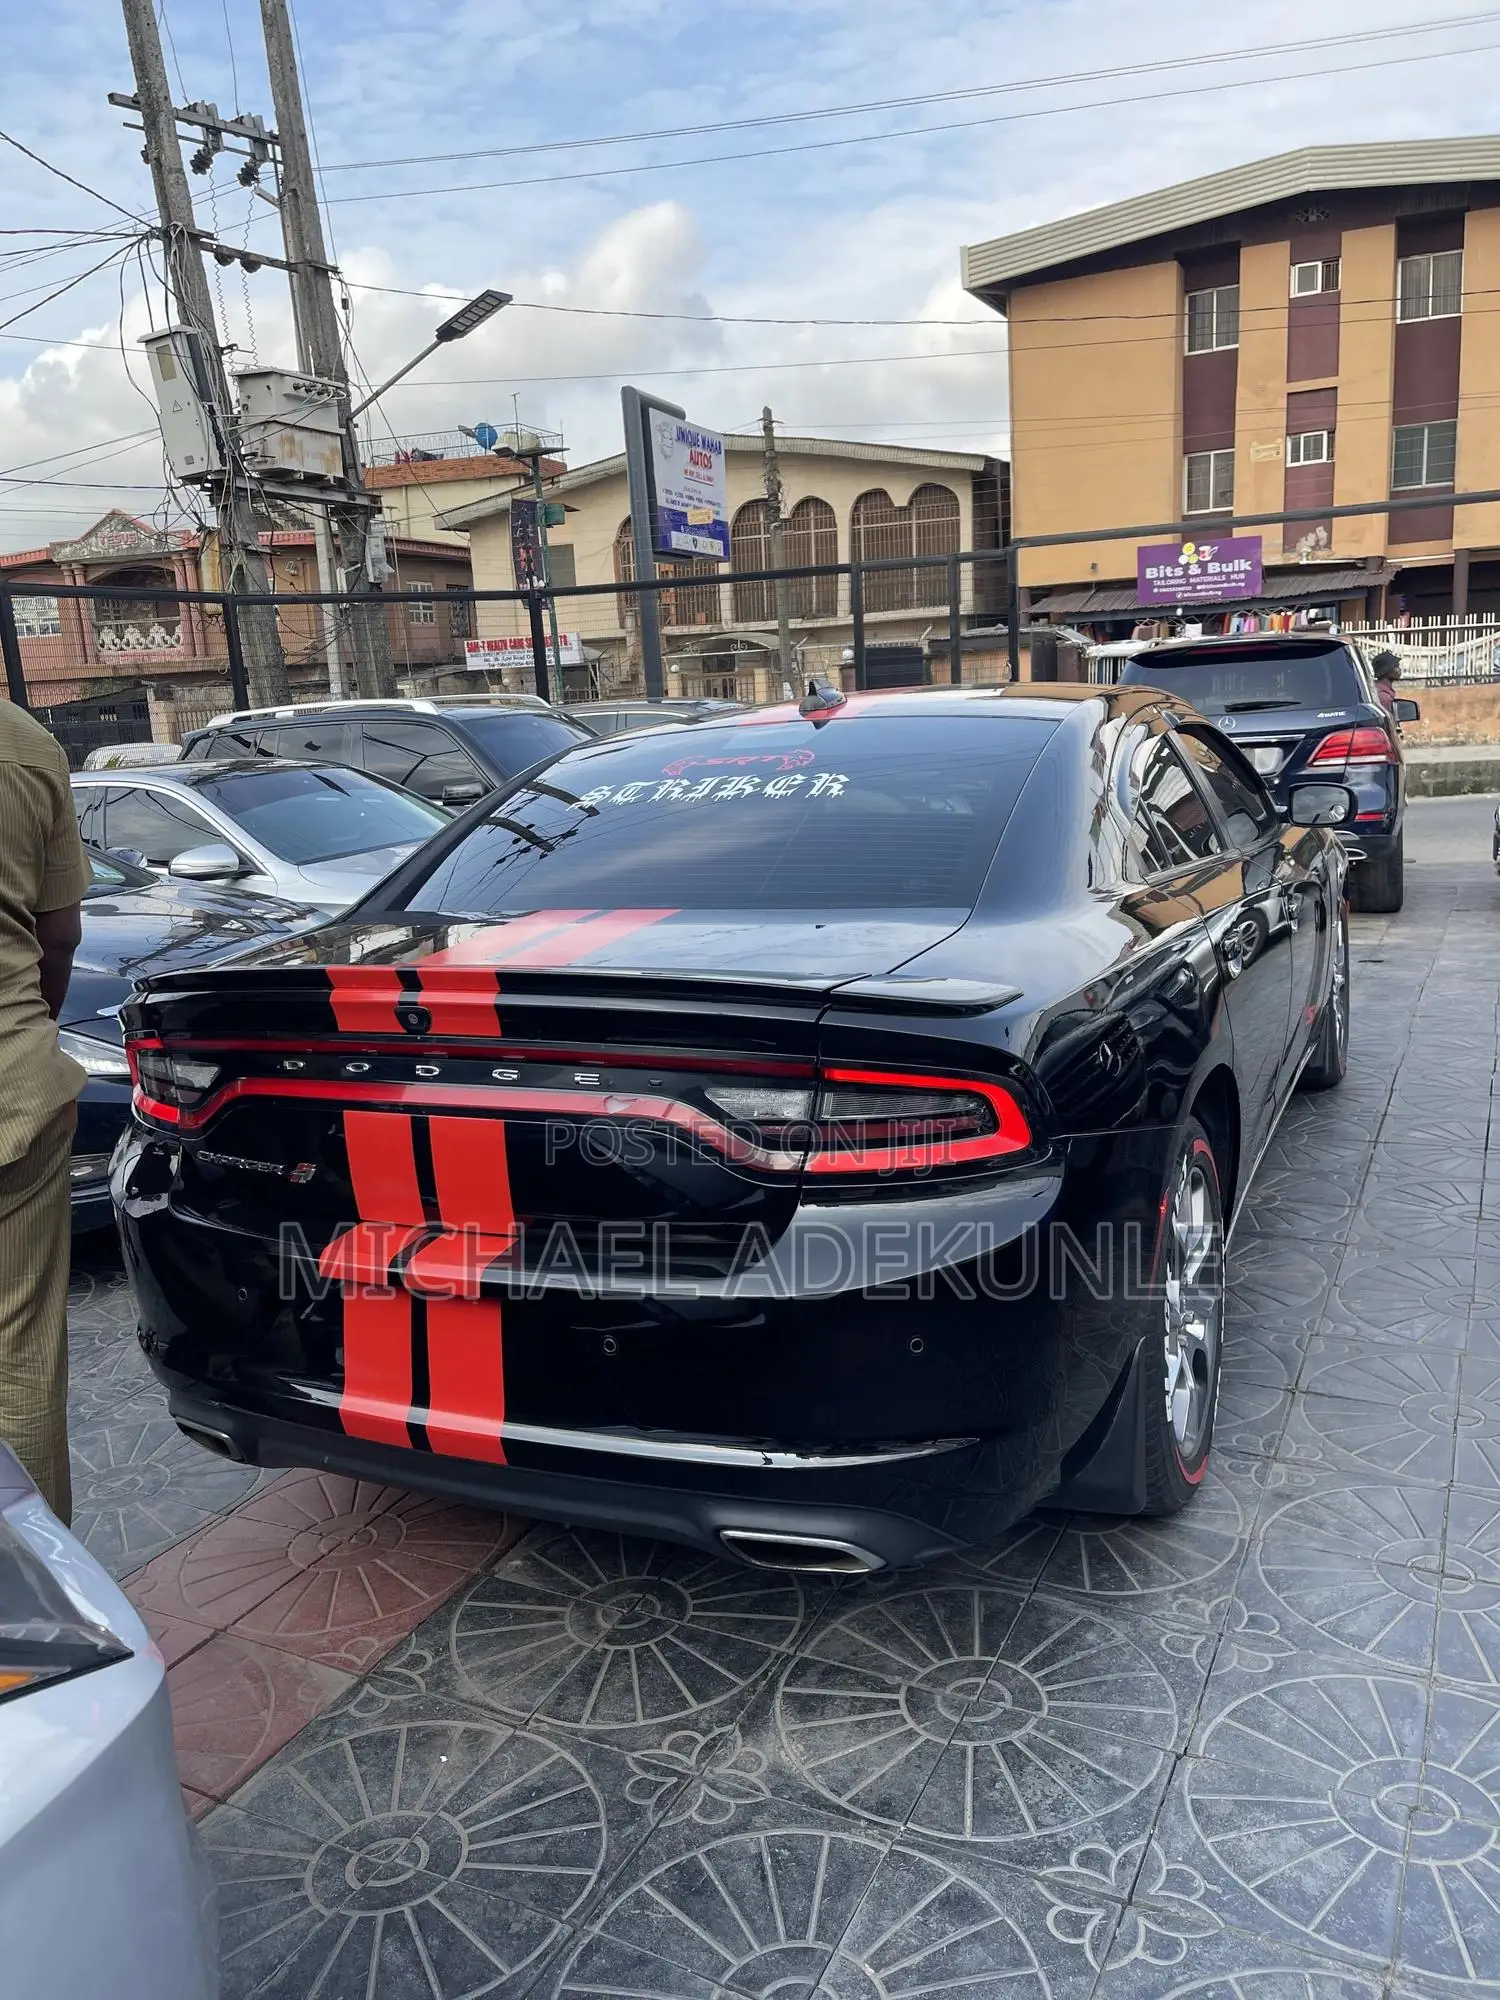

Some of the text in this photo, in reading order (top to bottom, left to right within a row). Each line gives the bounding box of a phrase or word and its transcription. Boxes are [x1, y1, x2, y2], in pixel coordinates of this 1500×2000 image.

[676, 425, 722, 455] UNIQUE WAHAB
[689, 449, 712, 469] AUTOS
[1145, 559, 1252, 579] Bits & Bulk
[1153, 572, 1245, 586] TAILORING MATERIALS HUB
[566, 772, 850, 811] STRIKER
[283, 1059, 601, 1086] DODGE
[196, 1150, 286, 1175] CHARGER
